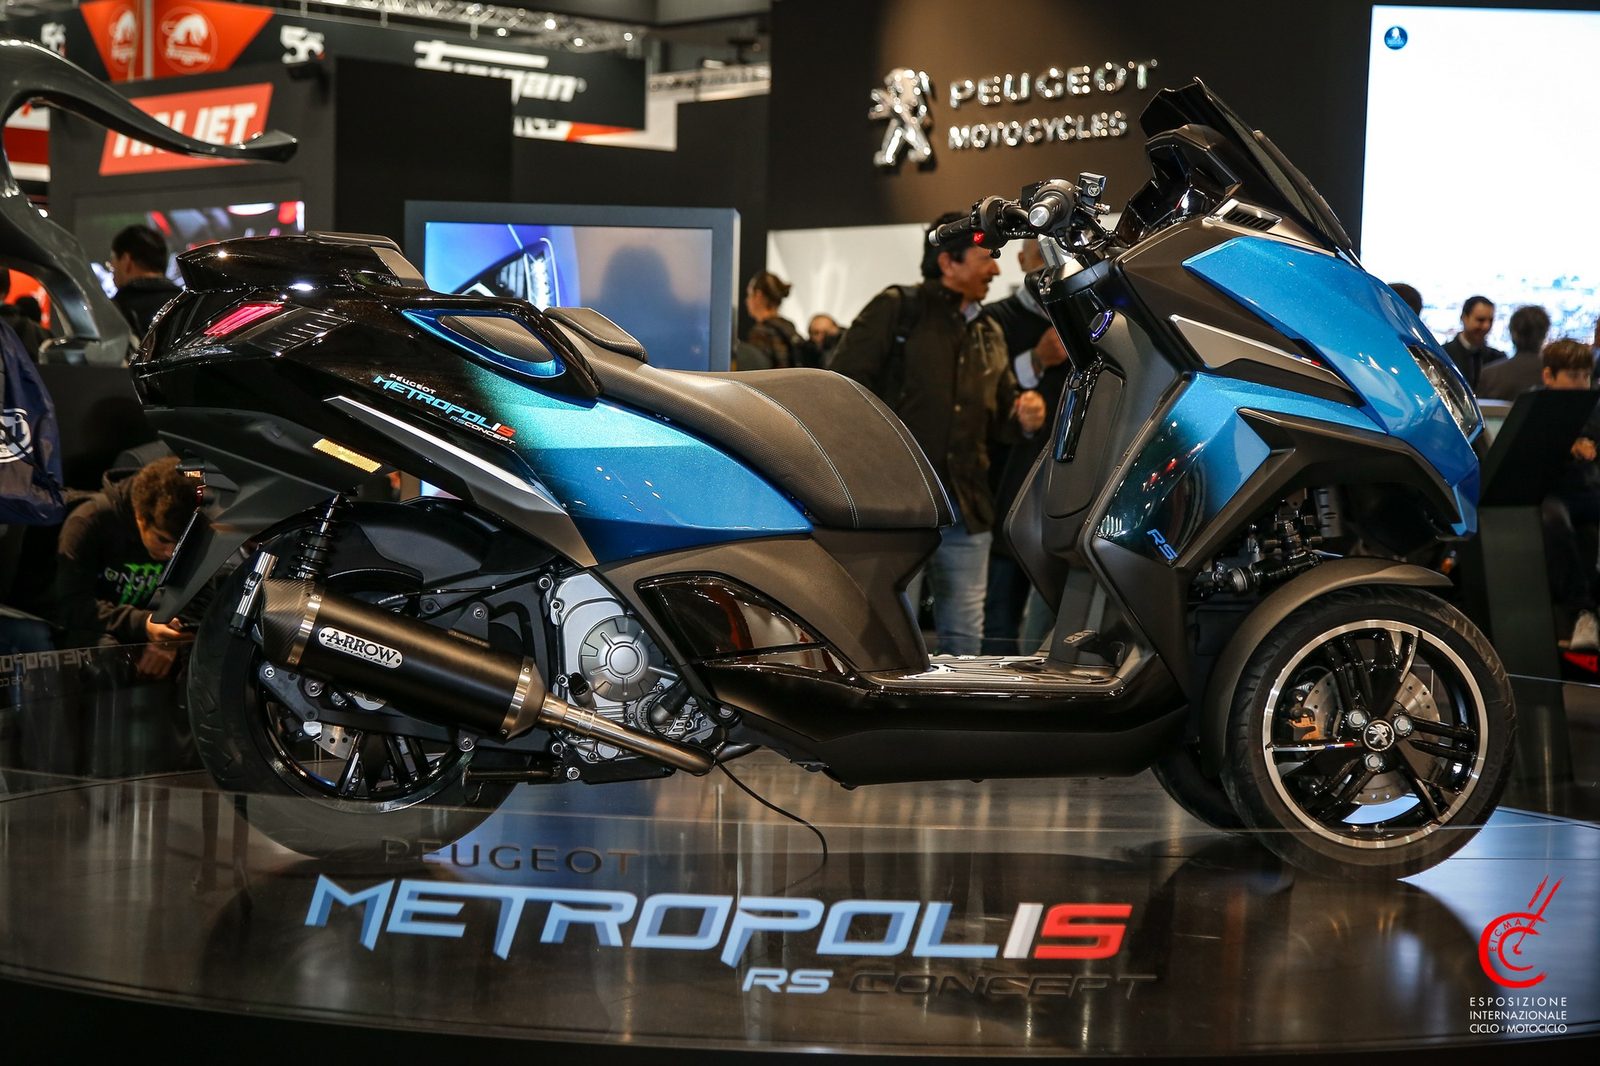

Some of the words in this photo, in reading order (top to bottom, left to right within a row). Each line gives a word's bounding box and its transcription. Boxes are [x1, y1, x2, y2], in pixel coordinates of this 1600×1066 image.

[950, 58, 1158, 108] PEUGEOT
[948, 110, 1128, 150] MOTOCYCLES
[389, 373, 437, 395] PEUGEOT
[373, 375, 516, 438] METROPOLIS
[1147, 528, 1178, 560] RS
[326, 630, 398, 662] ARROW
[382, 838, 639, 875] PEUGEOT
[304, 874, 1133, 968] METROPOLIS
[742, 967, 834, 994] RS
[849, 969, 1158, 1000] CONCEPT
